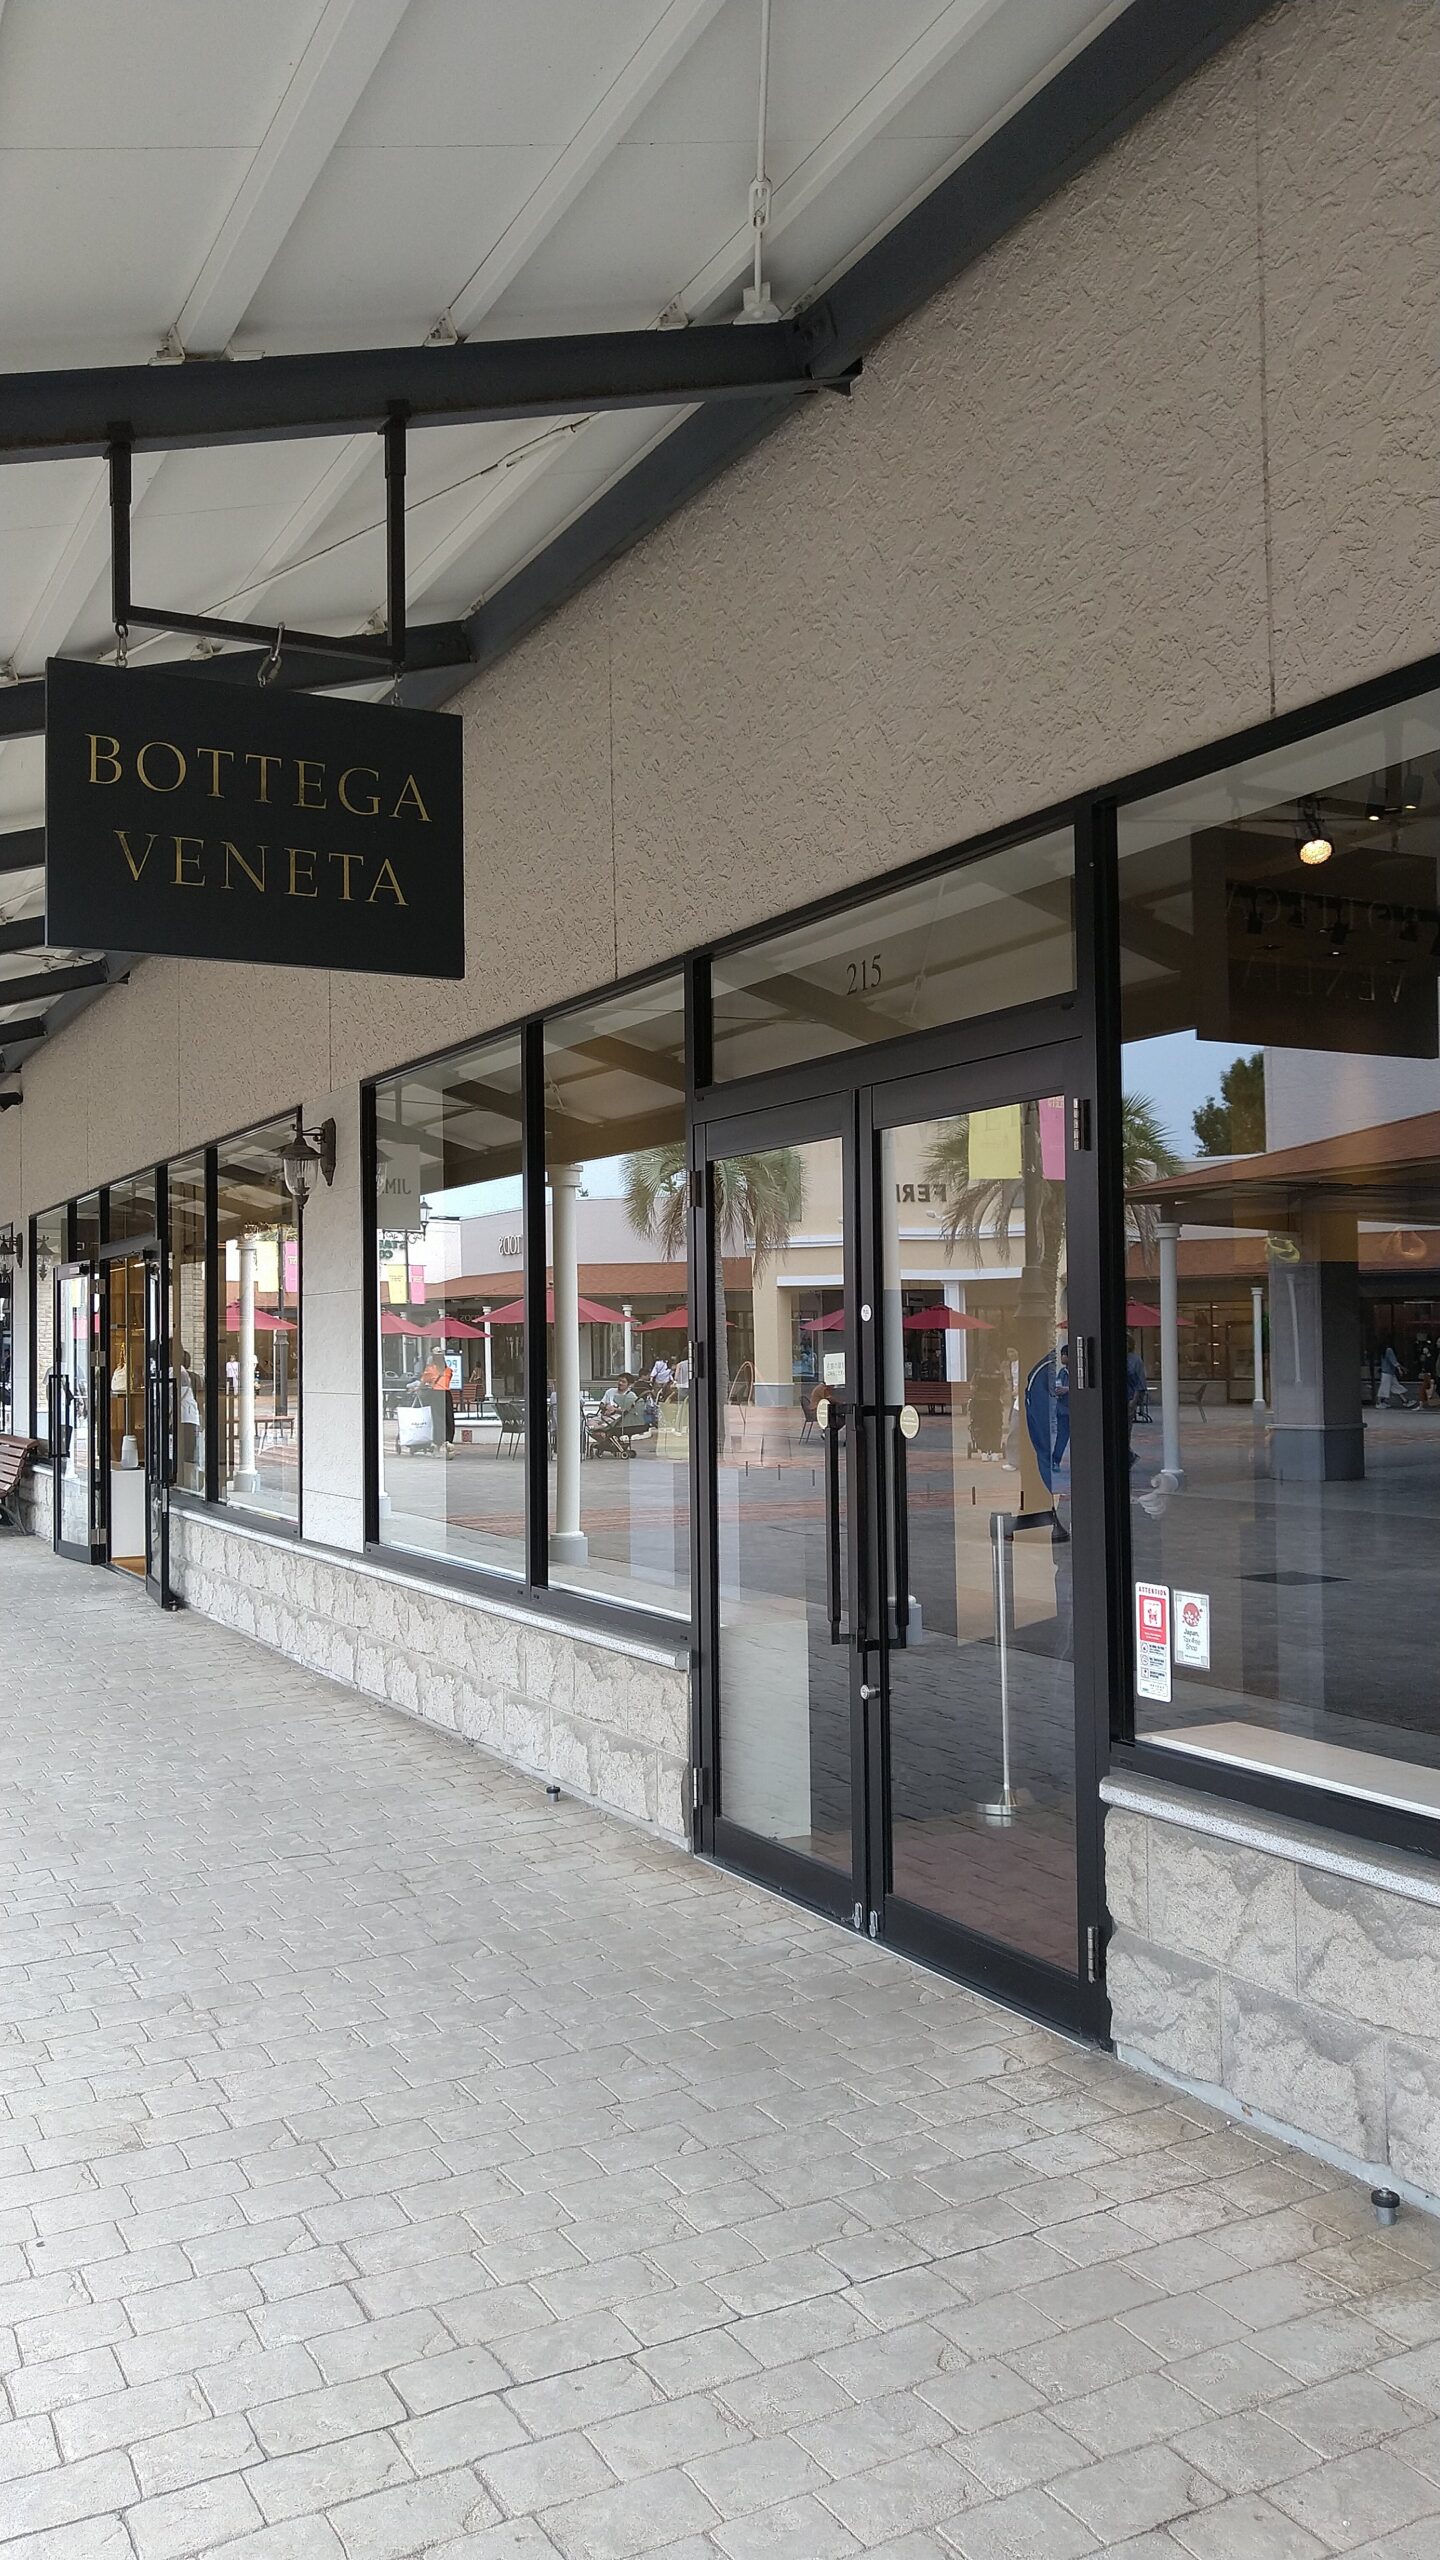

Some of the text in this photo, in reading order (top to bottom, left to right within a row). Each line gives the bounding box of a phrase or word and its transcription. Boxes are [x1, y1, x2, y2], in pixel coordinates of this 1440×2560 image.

[85, 733, 432, 823] BOTTEGA
[113, 829, 409, 907] VENETA
[846, 953, 882, 996] 215
[1138, 1586, 1167, 1596] ATTENTION
